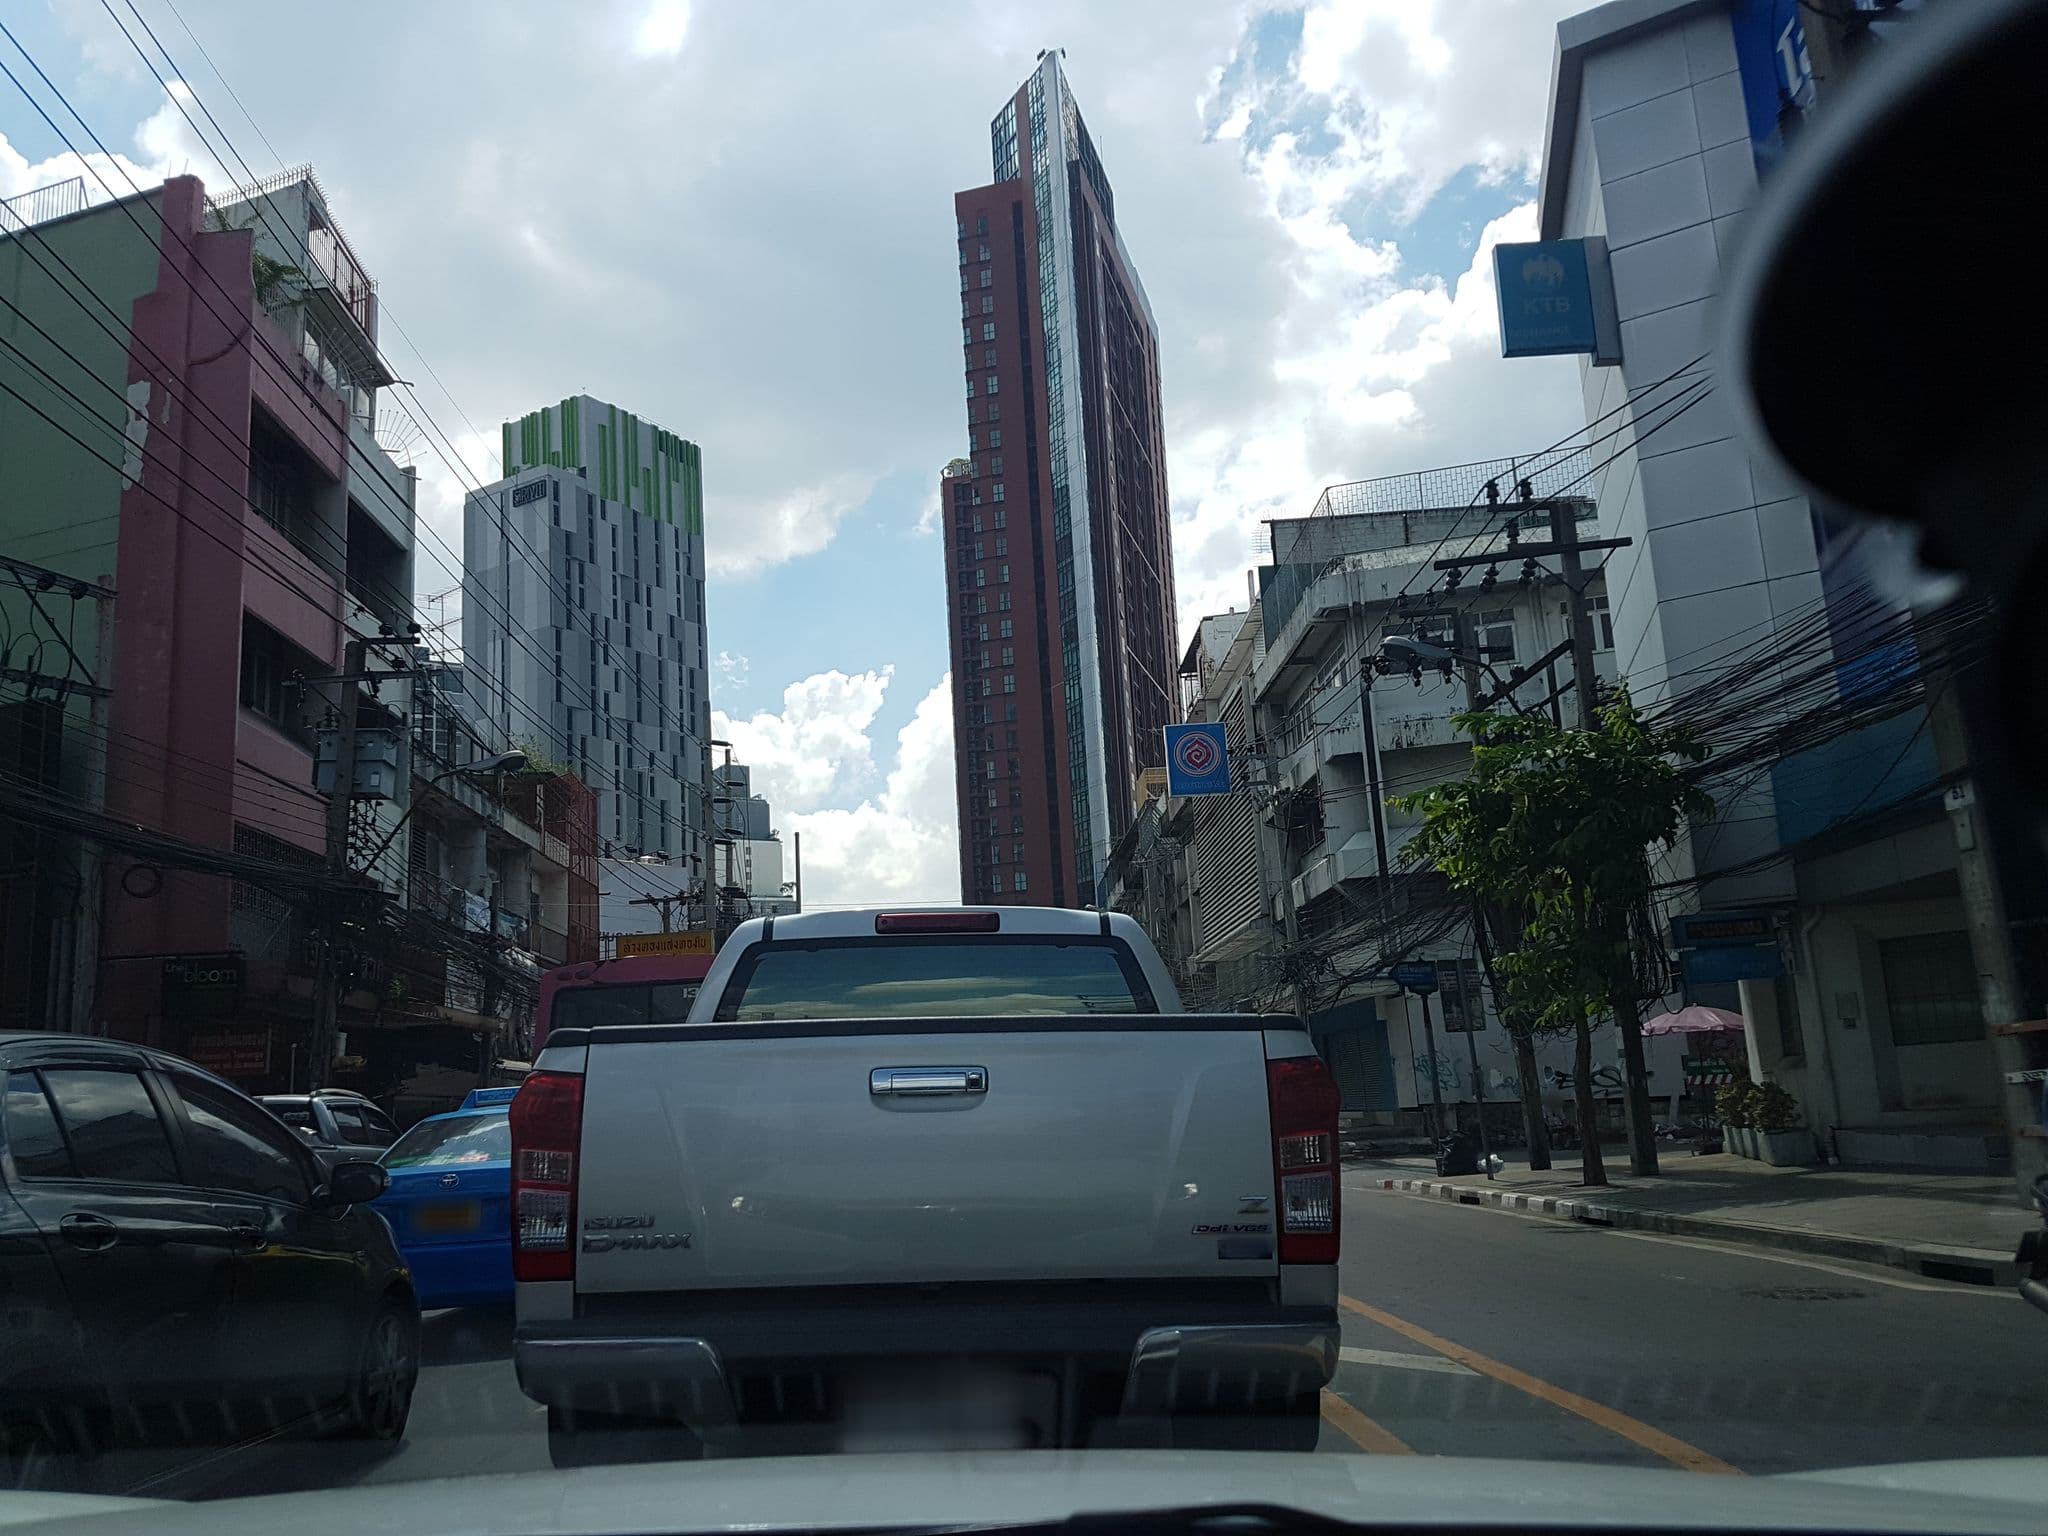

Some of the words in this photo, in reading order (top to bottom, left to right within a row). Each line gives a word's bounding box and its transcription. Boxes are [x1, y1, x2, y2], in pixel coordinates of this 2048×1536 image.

[1522, 295, 1571, 314] KTB
[184, 962, 238, 983] bloom
[584, 1214, 655, 1230] ISUZU
